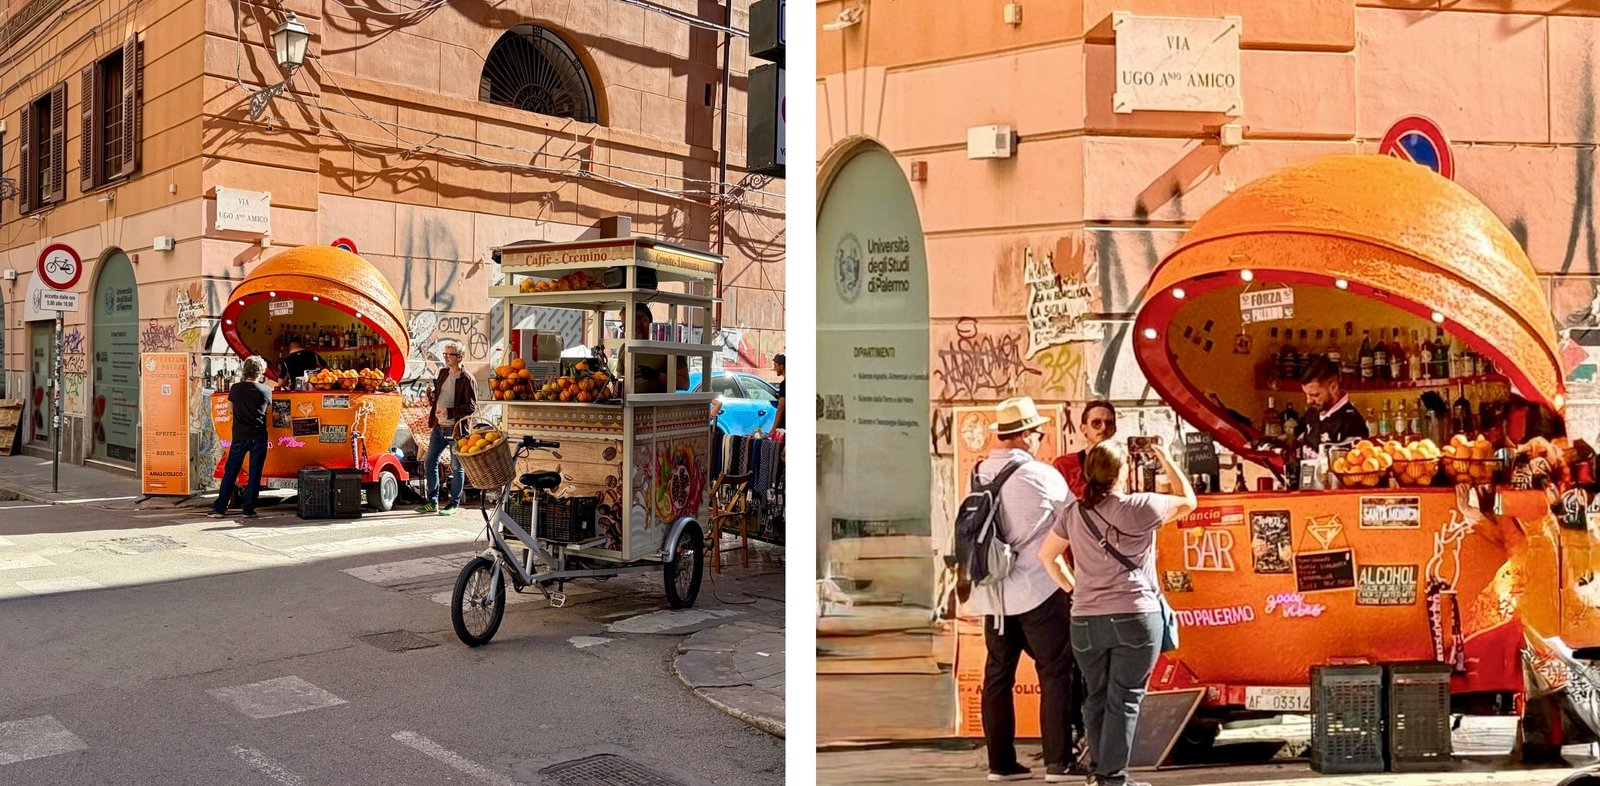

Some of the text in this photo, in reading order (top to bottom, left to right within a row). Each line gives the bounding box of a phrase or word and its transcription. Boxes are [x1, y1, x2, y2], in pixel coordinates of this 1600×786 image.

[1166, 36, 1190, 50] VIA
[1122, 71, 1154, 86] UGO
[1188, 72, 1235, 88] AMICO
[868, 236, 909, 254] Università
[562, 252, 607, 264] Cremino
[868, 256, 909, 276] degli Studi
[868, 276, 909, 292] di Palermo
[1251, 292, 1282, 306] FORZA
[854, 347, 895, 358] DIPARTIMENTI
[1364, 506, 1418, 521] SANTA MONICA
[1184, 529, 1235, 572] BAR
[1359, 566, 1416, 584] ALCOHOL
[1264, 593, 1305, 614] good
[1282, 602, 1327, 617] vibes
[1193, 605, 1254, 626] PALERMO
[1249, 696, 1262, 708] AF
